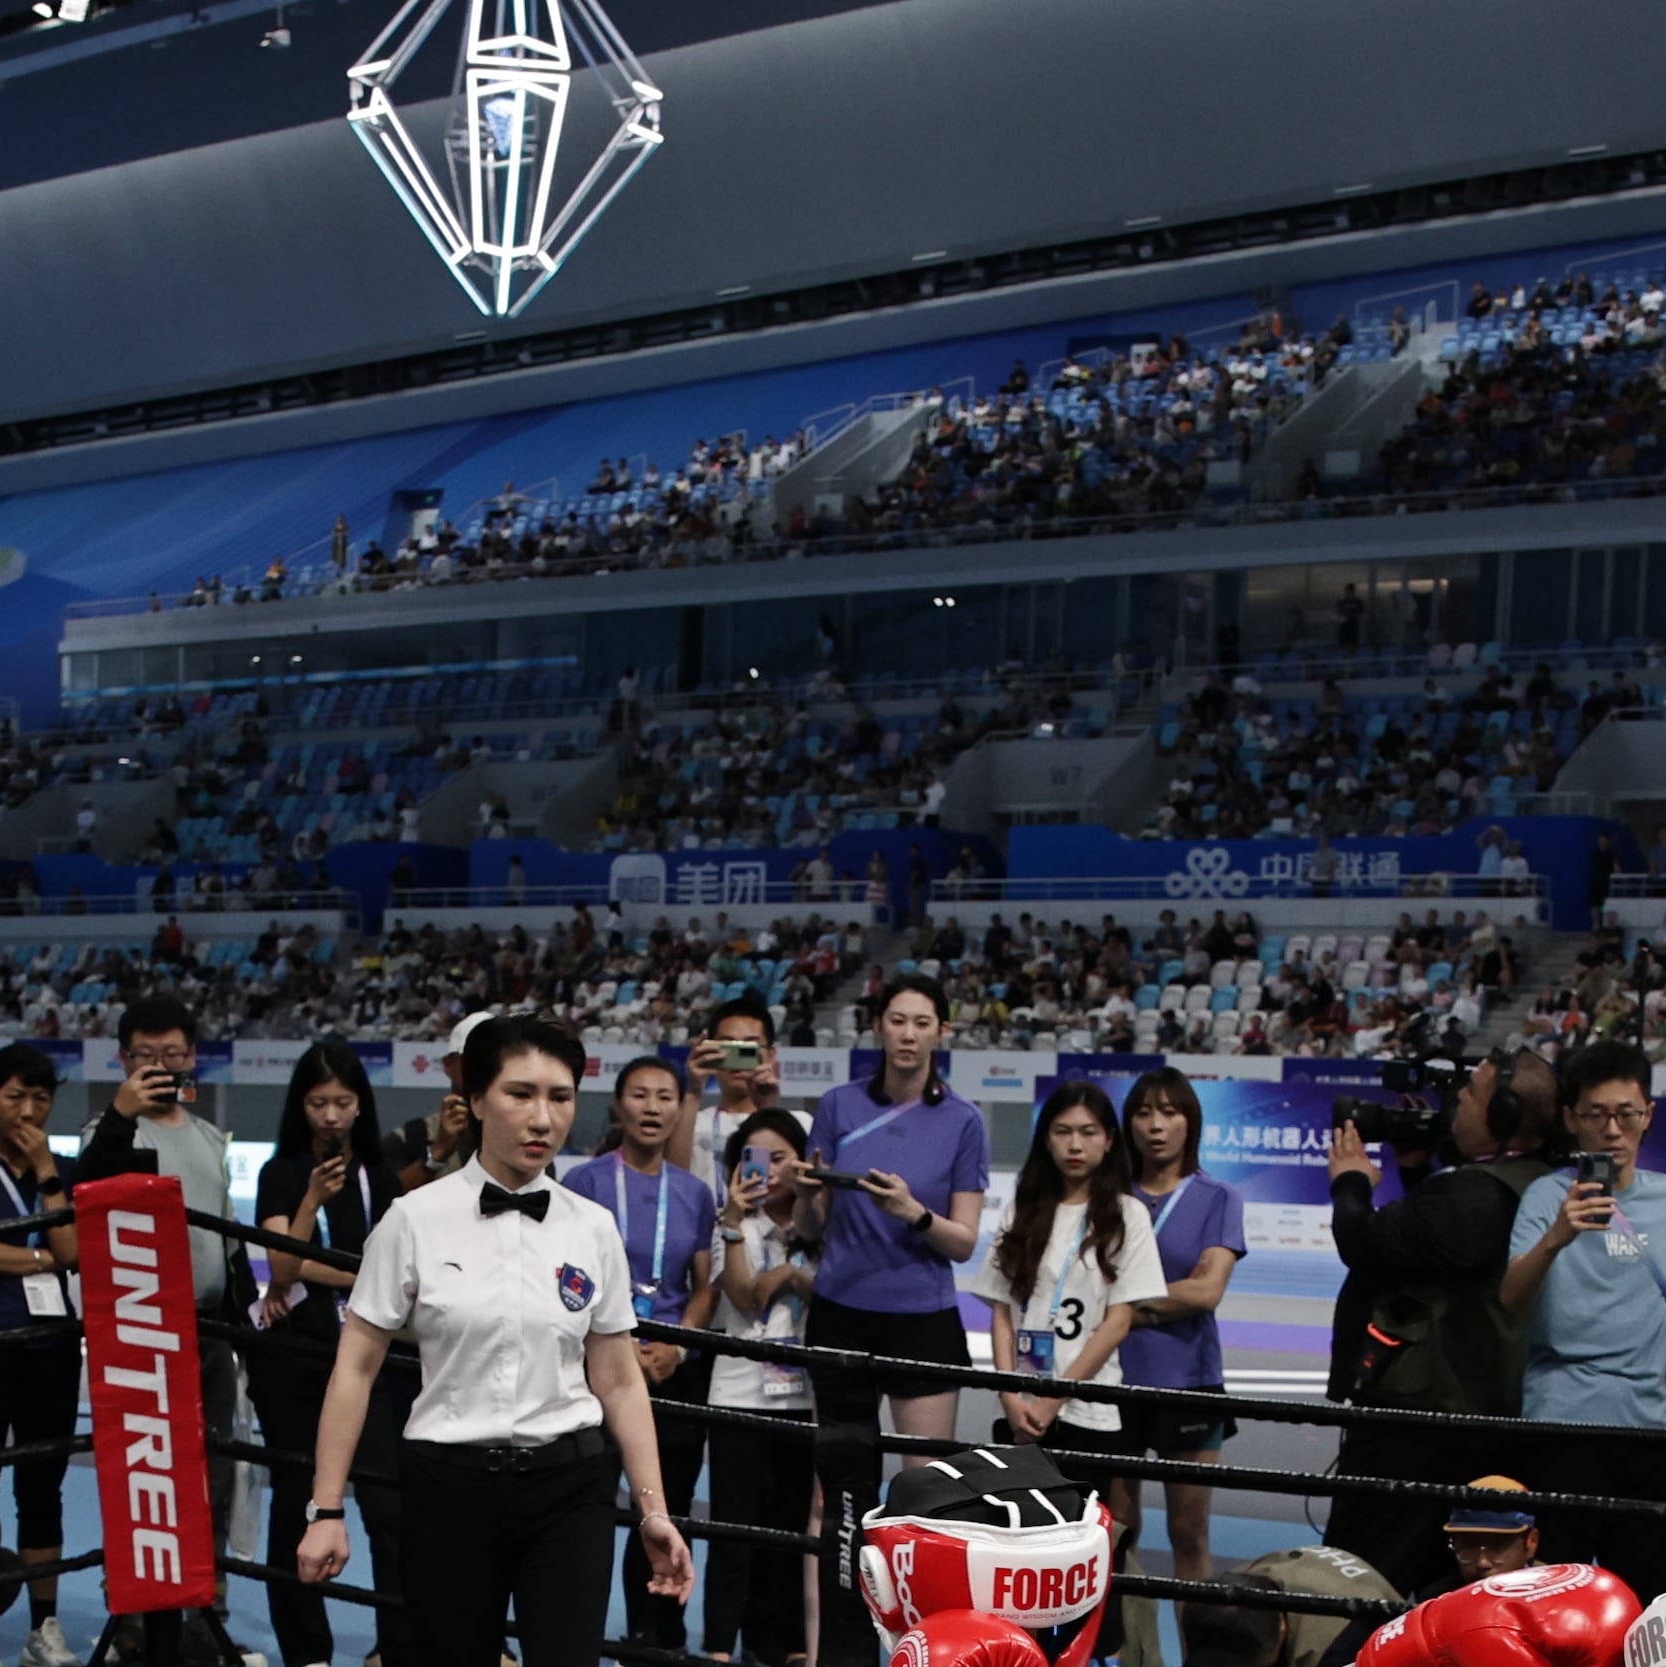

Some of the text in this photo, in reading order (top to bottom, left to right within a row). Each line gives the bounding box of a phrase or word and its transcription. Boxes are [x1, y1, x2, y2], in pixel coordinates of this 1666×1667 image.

[1054, 1297, 1085, 1340] 3
[102, 1208, 183, 1586] UNITREE
[837, 1489, 858, 1591] UNITREE
[992, 1555, 1098, 1611] FORCE
